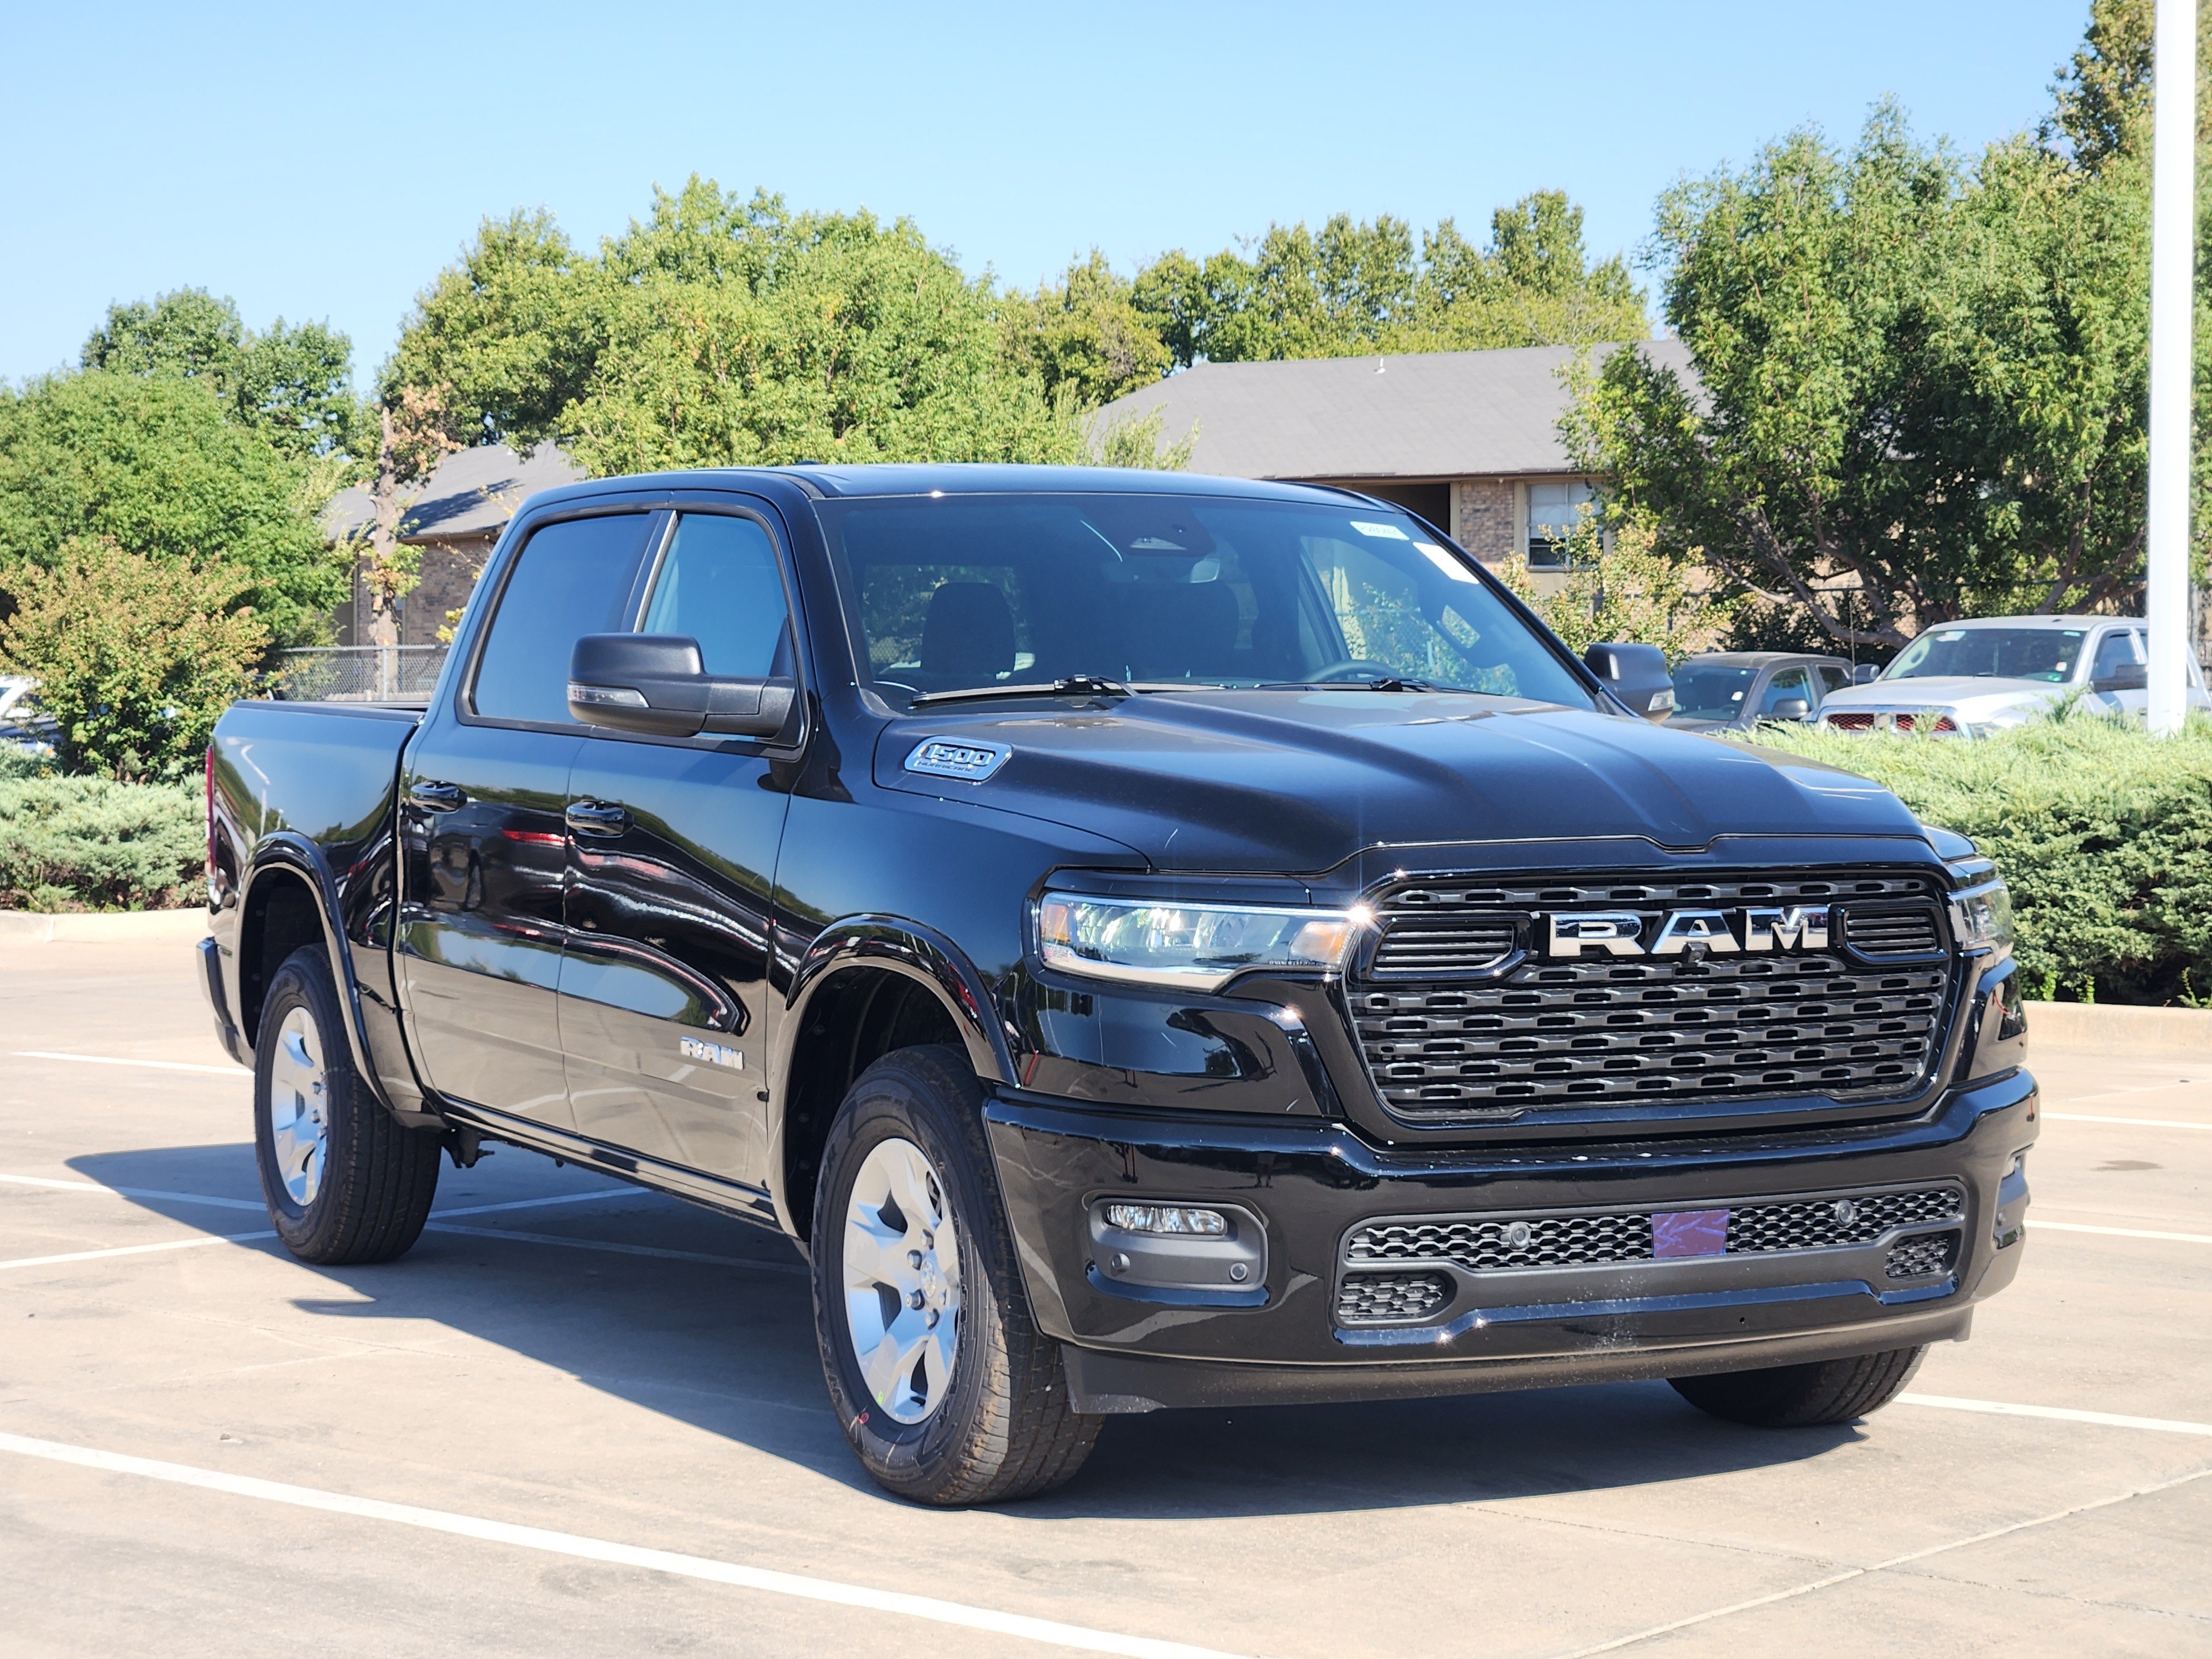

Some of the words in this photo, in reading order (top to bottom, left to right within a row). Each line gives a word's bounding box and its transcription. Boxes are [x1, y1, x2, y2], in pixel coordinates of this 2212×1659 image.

[926, 744, 994, 766] 1500
[1550, 905, 1828, 956] RAM
[680, 1036, 744, 1070] RAM
